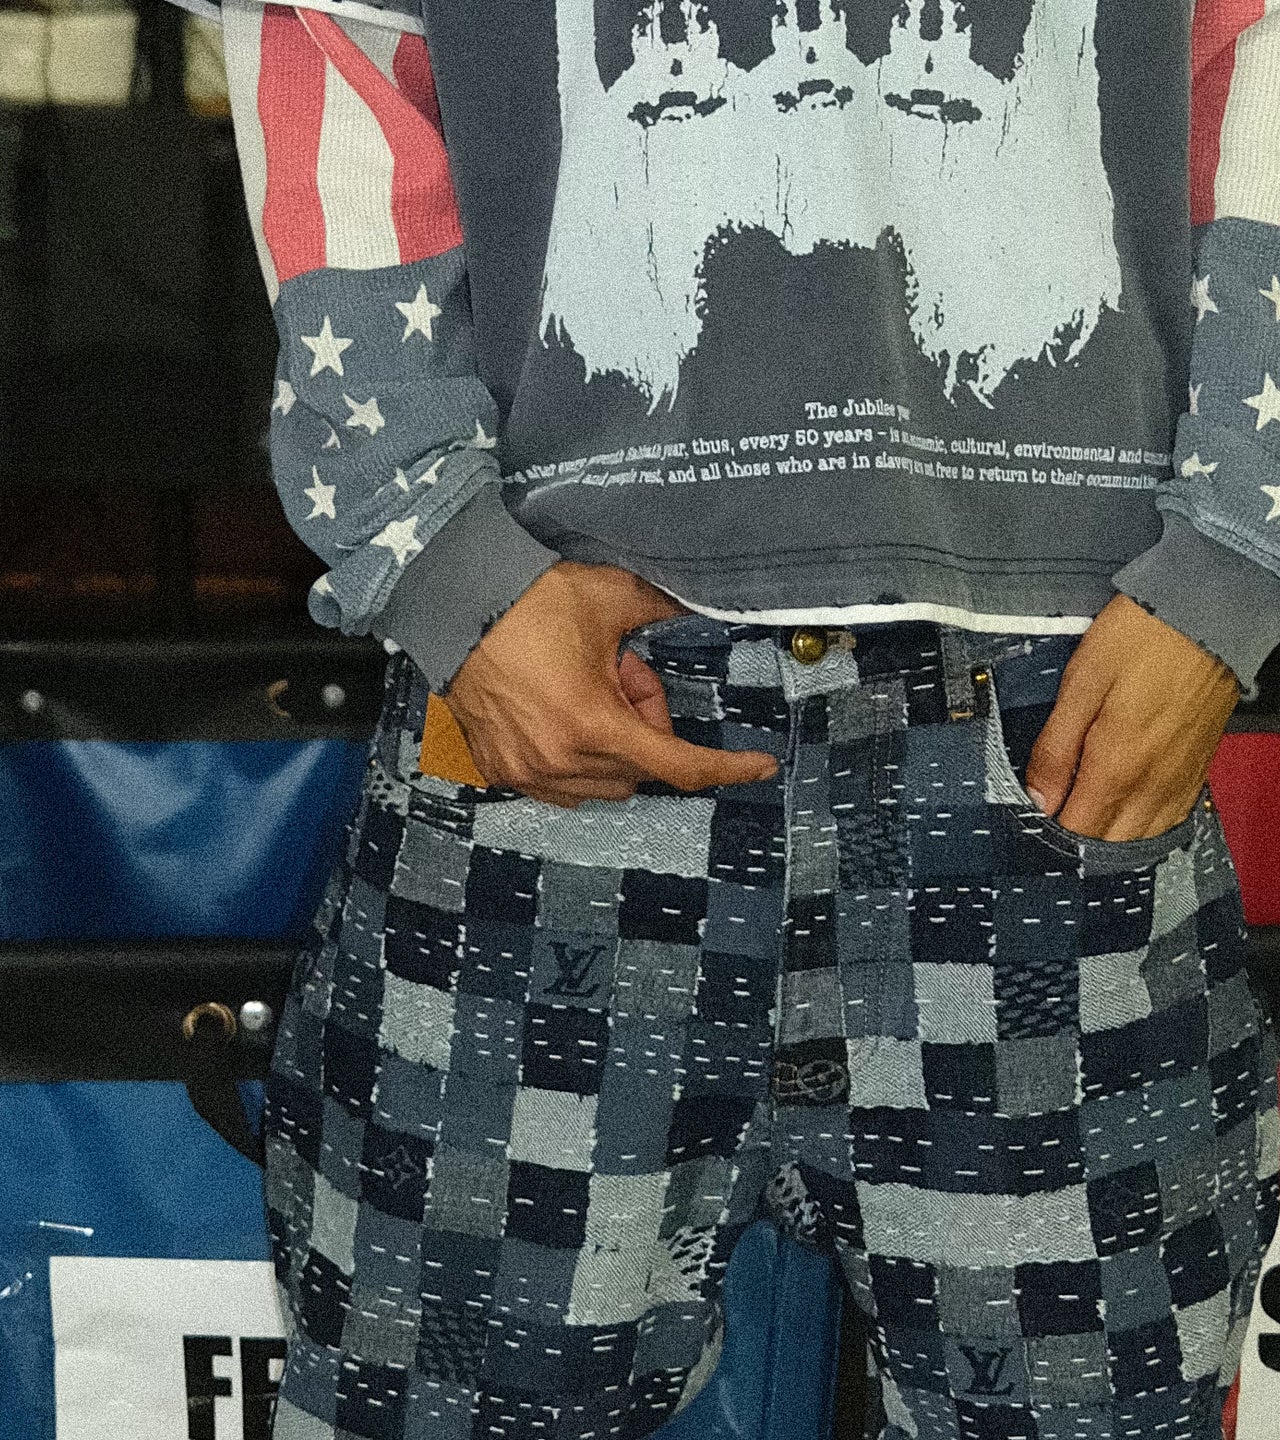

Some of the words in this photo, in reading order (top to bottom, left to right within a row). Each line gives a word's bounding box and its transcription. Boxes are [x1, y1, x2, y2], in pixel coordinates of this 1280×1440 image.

[804, 401, 838, 420] The
[691, 438, 737, 457] thus,
[739, 432, 790, 452] every
[794, 429, 819, 447] 50
[823, 428, 874, 449] years
[950, 437, 1011, 460] cultural,
[1013, 441, 1116, 463] environmental
[1118, 448, 1143, 465] and
[668, 464, 698, 484] and
[700, 462, 722, 481] all
[724, 460, 771, 479] those
[775, 455, 814, 475] who
[817, 455, 847, 472] are
[851, 451, 871, 470] in
[961, 465, 975, 481] to
[978, 467, 1029, 484] return
[1031, 467, 1048, 484] to
[1051, 467, 1085, 488] their
